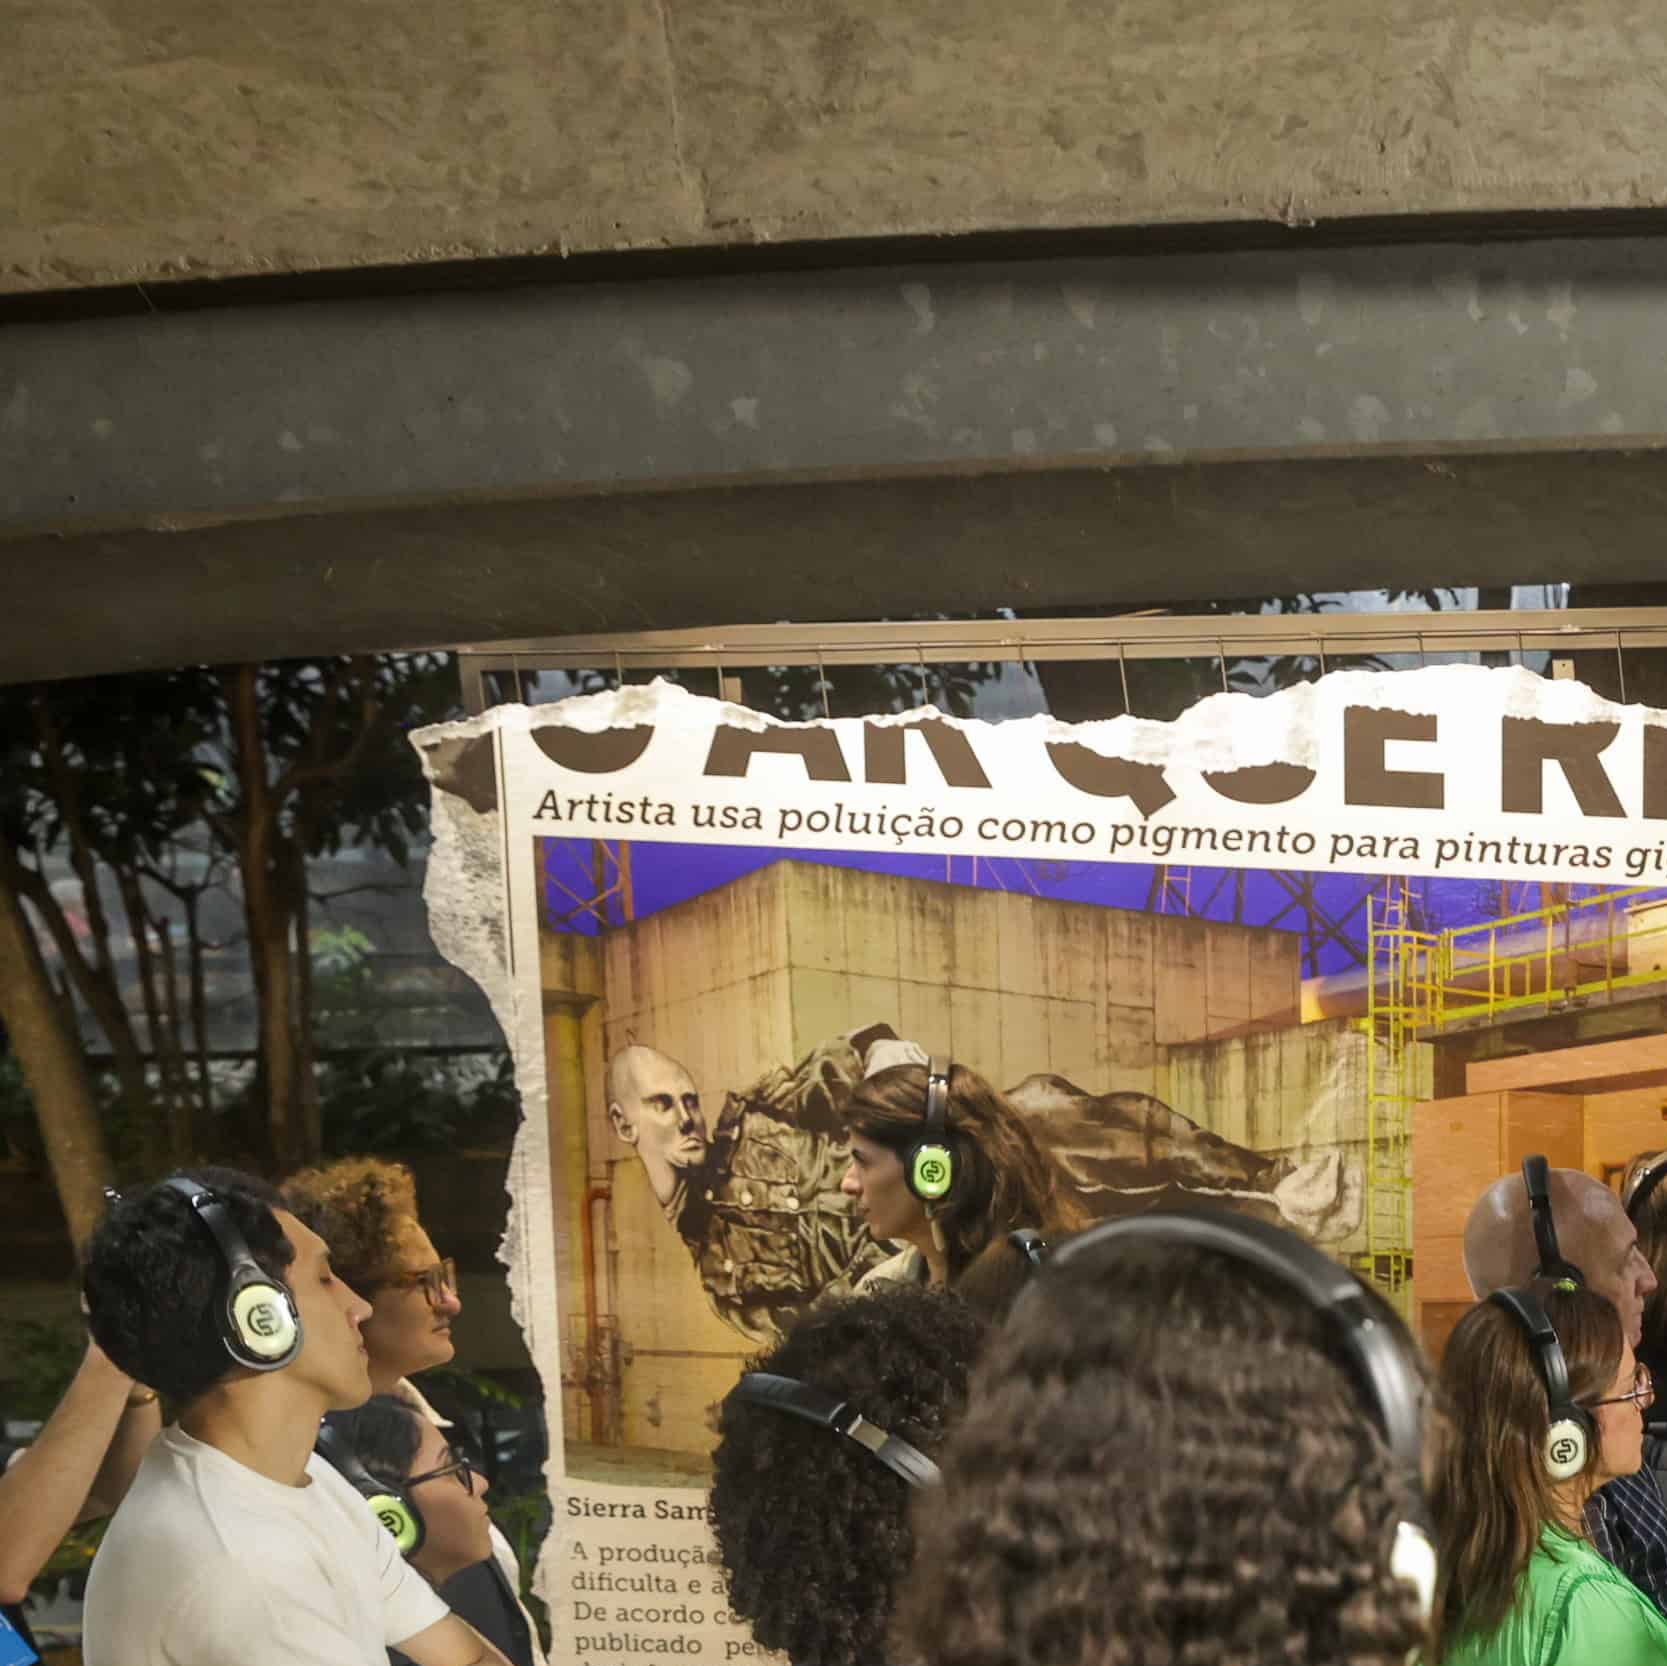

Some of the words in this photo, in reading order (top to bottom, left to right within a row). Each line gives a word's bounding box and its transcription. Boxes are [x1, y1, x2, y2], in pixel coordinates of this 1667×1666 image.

[532, 789, 676, 827] Artista
[691, 802, 764, 831] usa
[777, 801, 964, 845] poluição
[977, 817, 1097, 845] como
[1109, 820, 1316, 857] pigmento
[1328, 831, 1420, 863] para
[1434, 831, 1613, 869] pinturas
[566, 1496, 647, 1519] Sierra
[569, 1540, 589, 1561] A
[570, 1571, 678, 1593] dificulta
[687, 1578, 702, 1595] e
[573, 1600, 607, 1622] De
[615, 1603, 705, 1625] acordo
[574, 1631, 703, 1656] publicado
